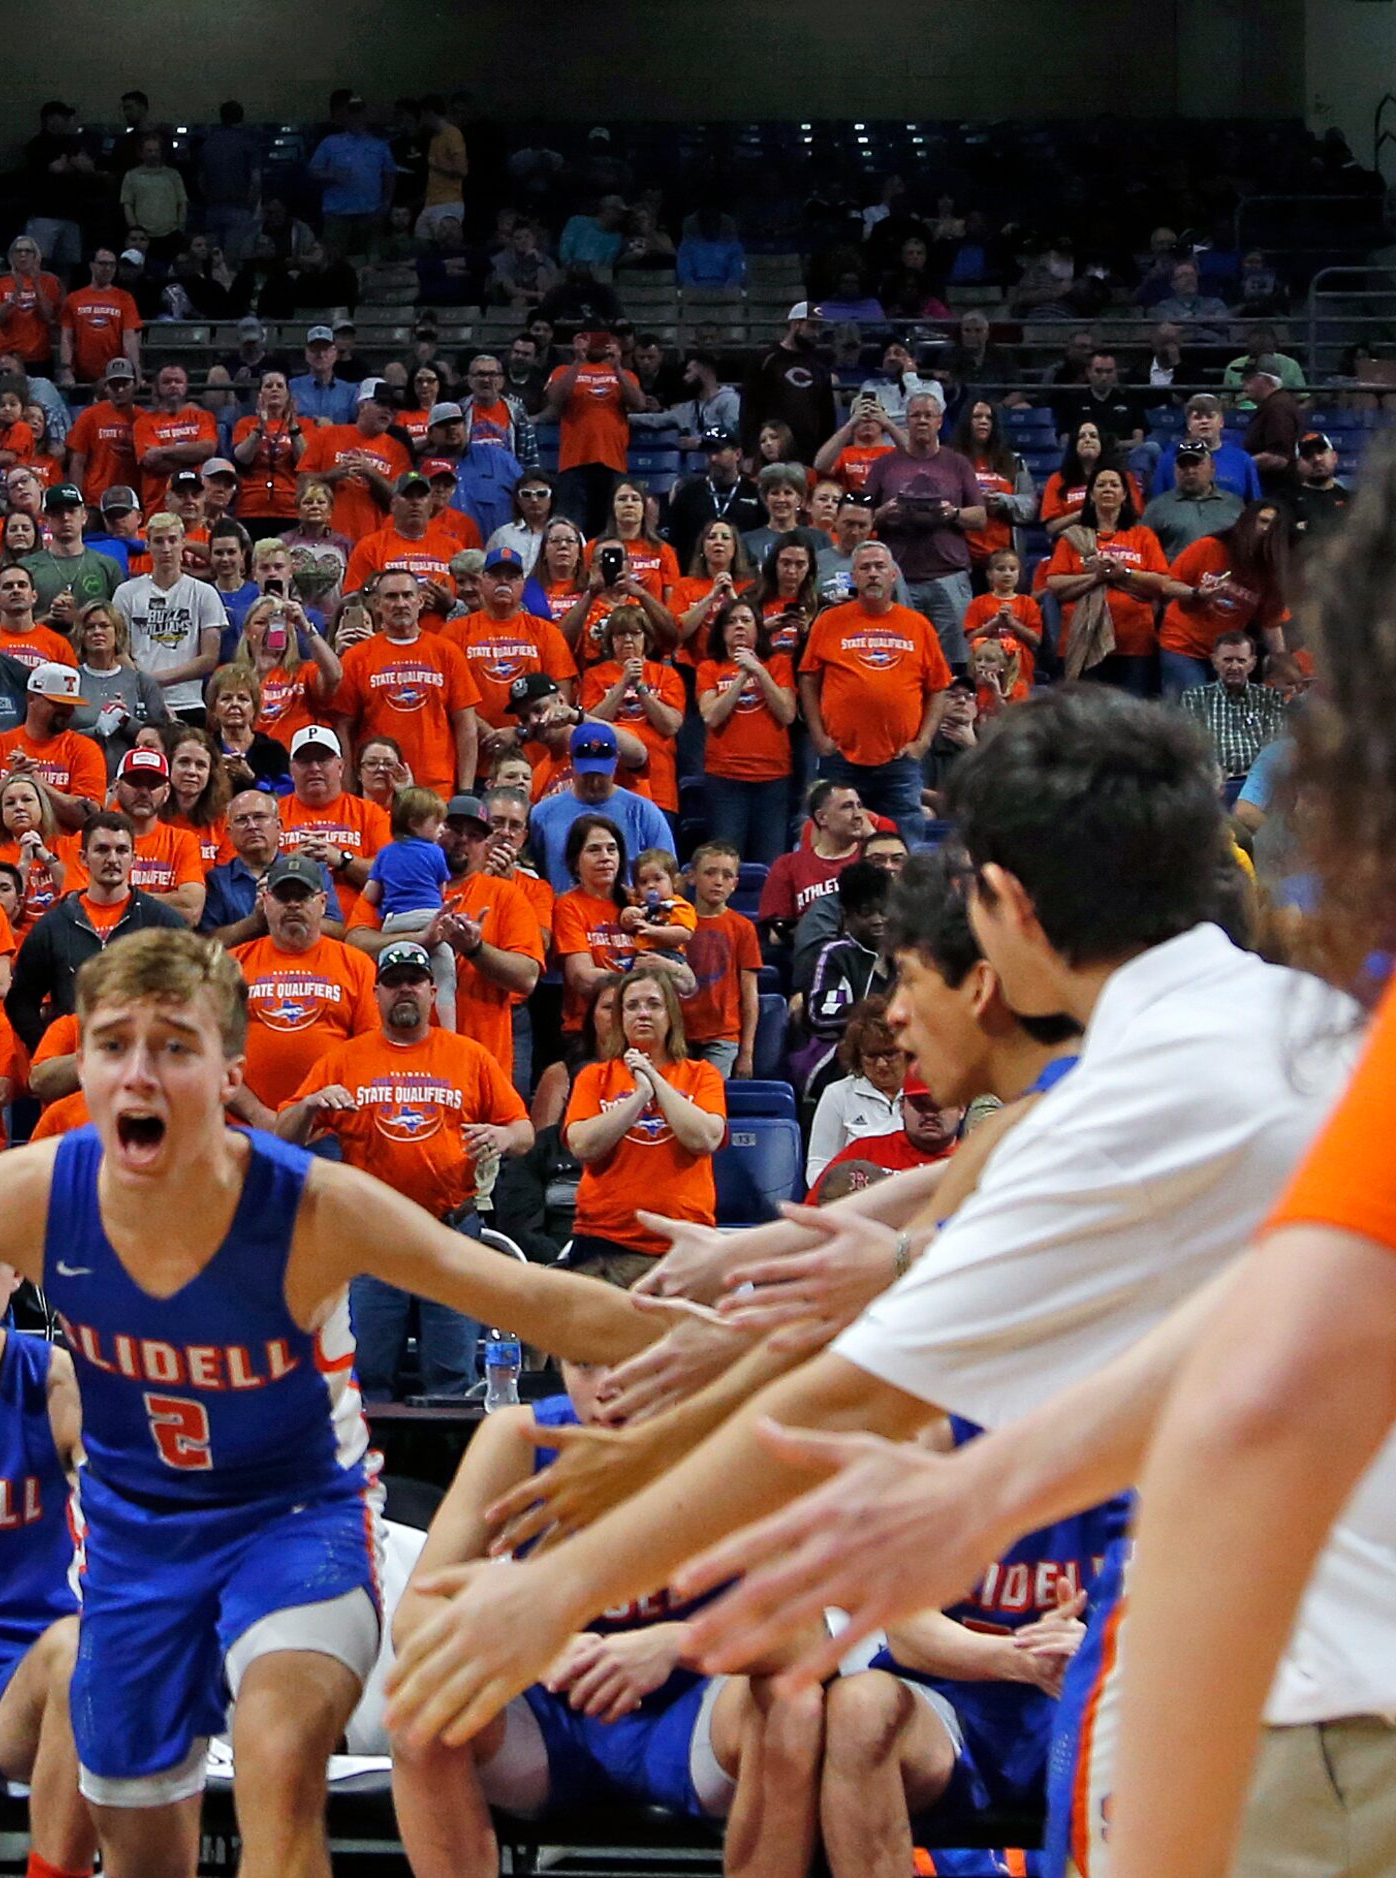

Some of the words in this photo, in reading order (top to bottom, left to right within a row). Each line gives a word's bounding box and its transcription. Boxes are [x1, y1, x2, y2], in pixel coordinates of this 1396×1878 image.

[785, 367, 813, 388] C
[467, 646, 491, 659] STATE
[493, 645, 538, 659] QUALIFIERS
[64, 677, 77, 692] T
[370, 672, 395, 688] STATE
[397, 672, 443, 687] QUALIFIERS
[309, 728, 318, 739] P
[247, 983, 275, 998] TATE
[277, 983, 341, 1003] QUALIFIERS
[356, 1086, 393, 1106] STATE
[395, 1086, 463, 1109] QUALIFIERS
[738, 1134, 750, 1144] 13
[144, 1391, 214, 1472] 2
